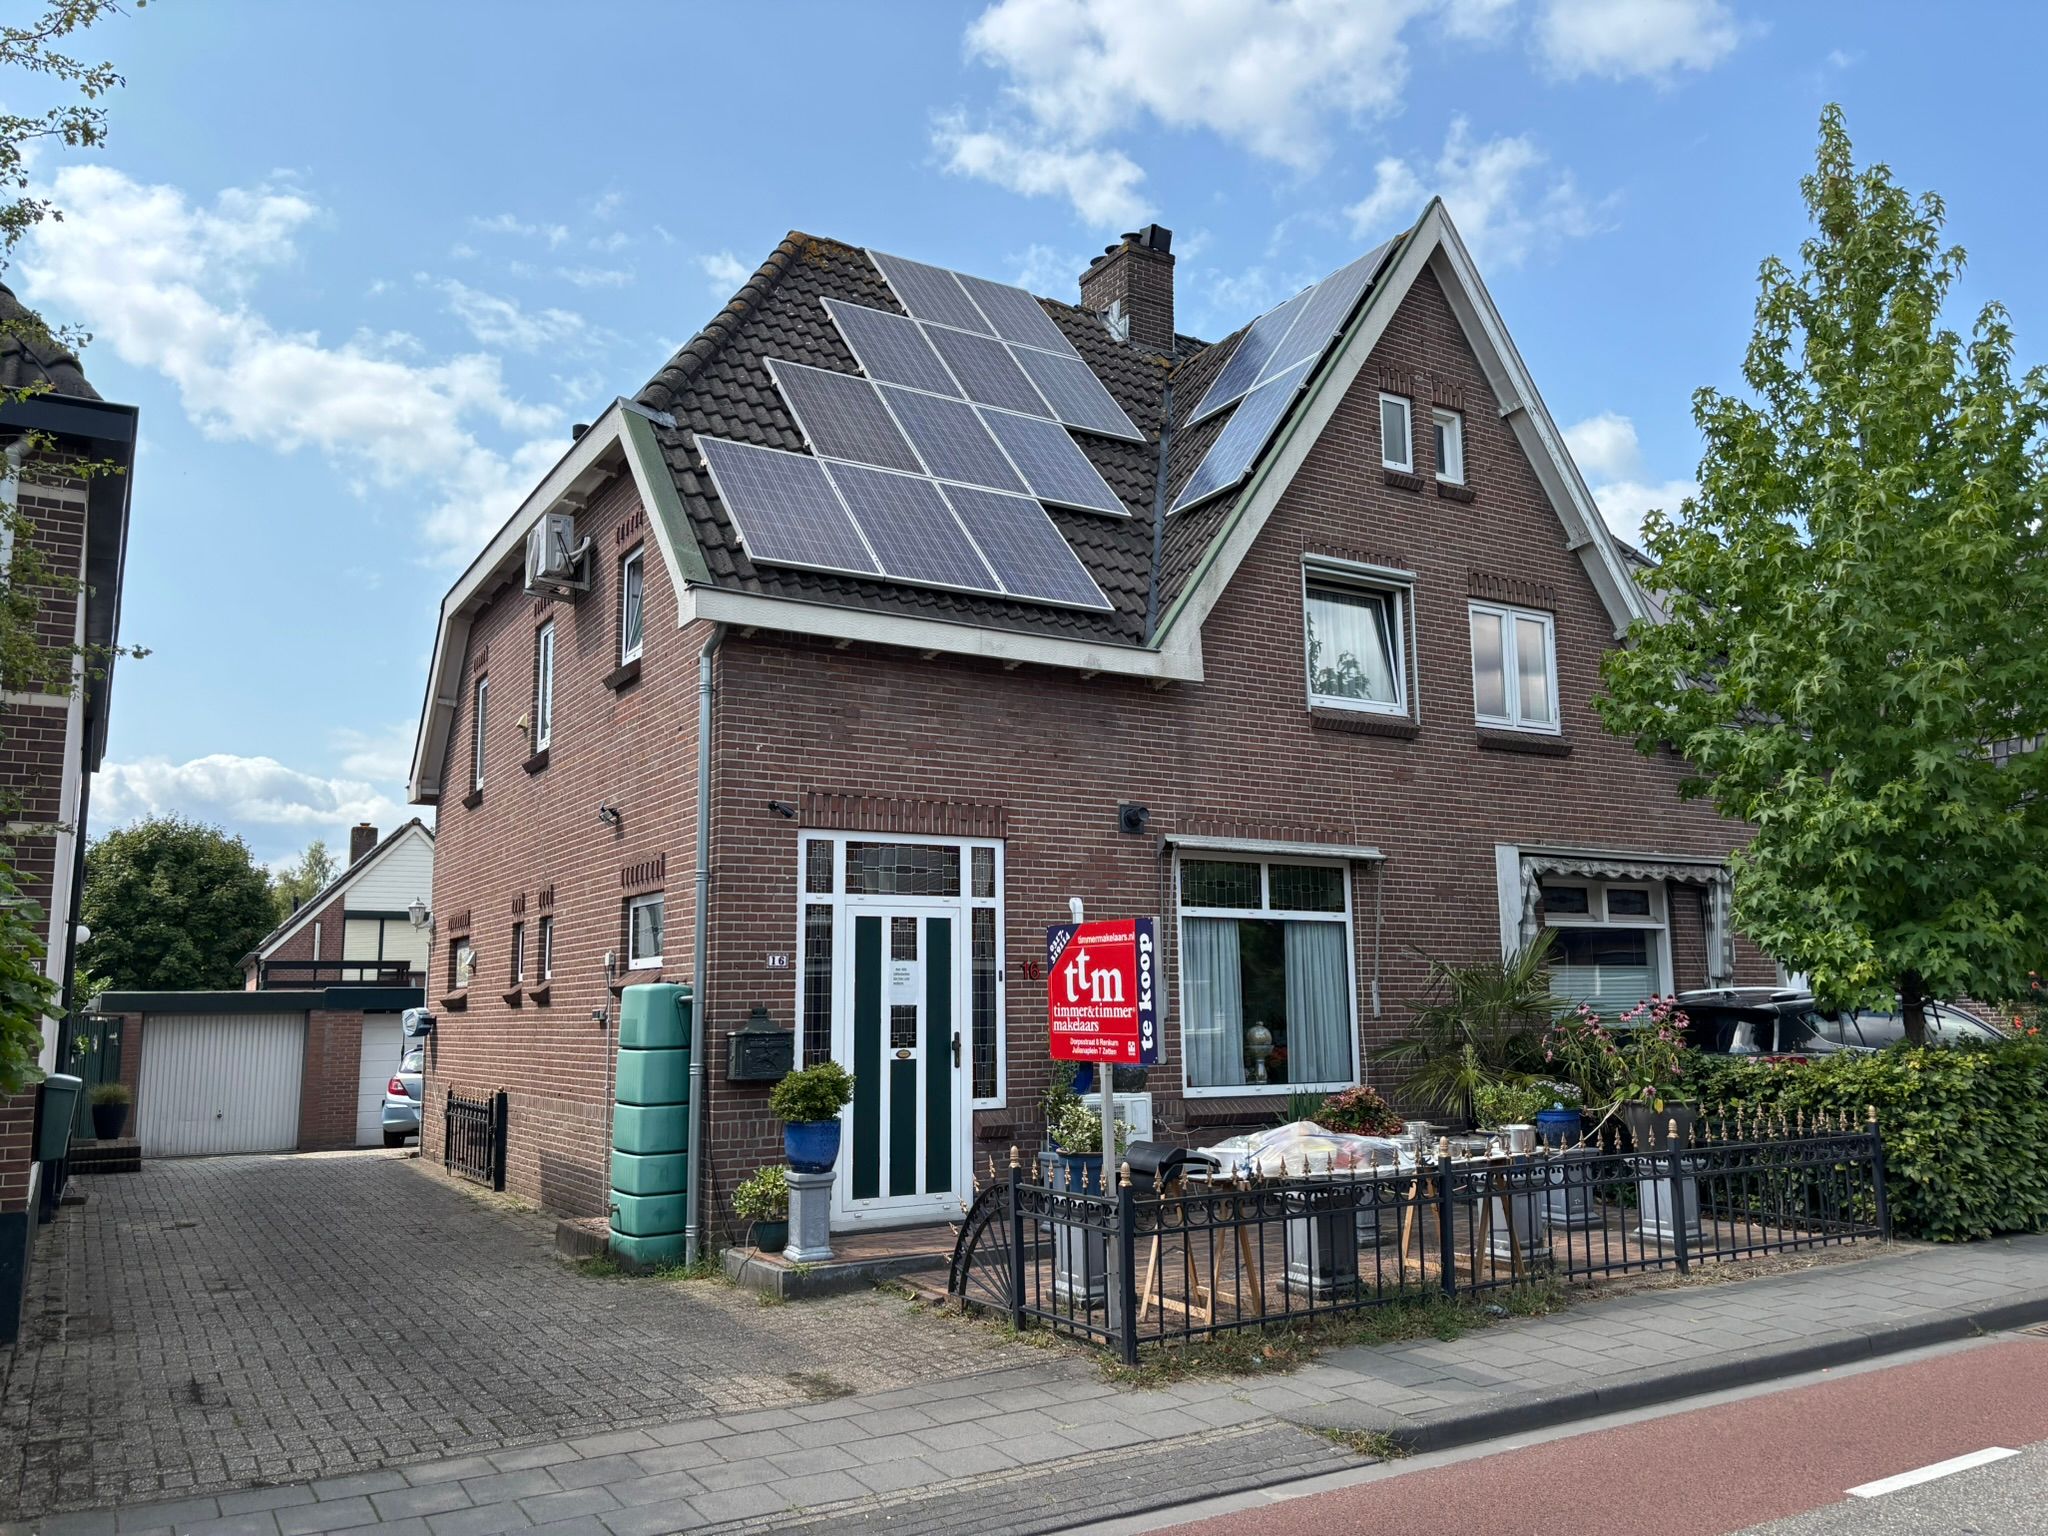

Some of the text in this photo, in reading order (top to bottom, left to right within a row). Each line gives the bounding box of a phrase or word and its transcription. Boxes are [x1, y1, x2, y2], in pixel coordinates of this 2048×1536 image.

[1078, 932, 1135, 944] timmermakelaars.nl
[772, 956, 785, 965] 16
[1020, 959, 1041, 981] 16
[1064, 948, 1125, 1002] ttm
[1139, 933, 1153, 1051] te koop
[1053, 1017, 1099, 1032] makelaars
